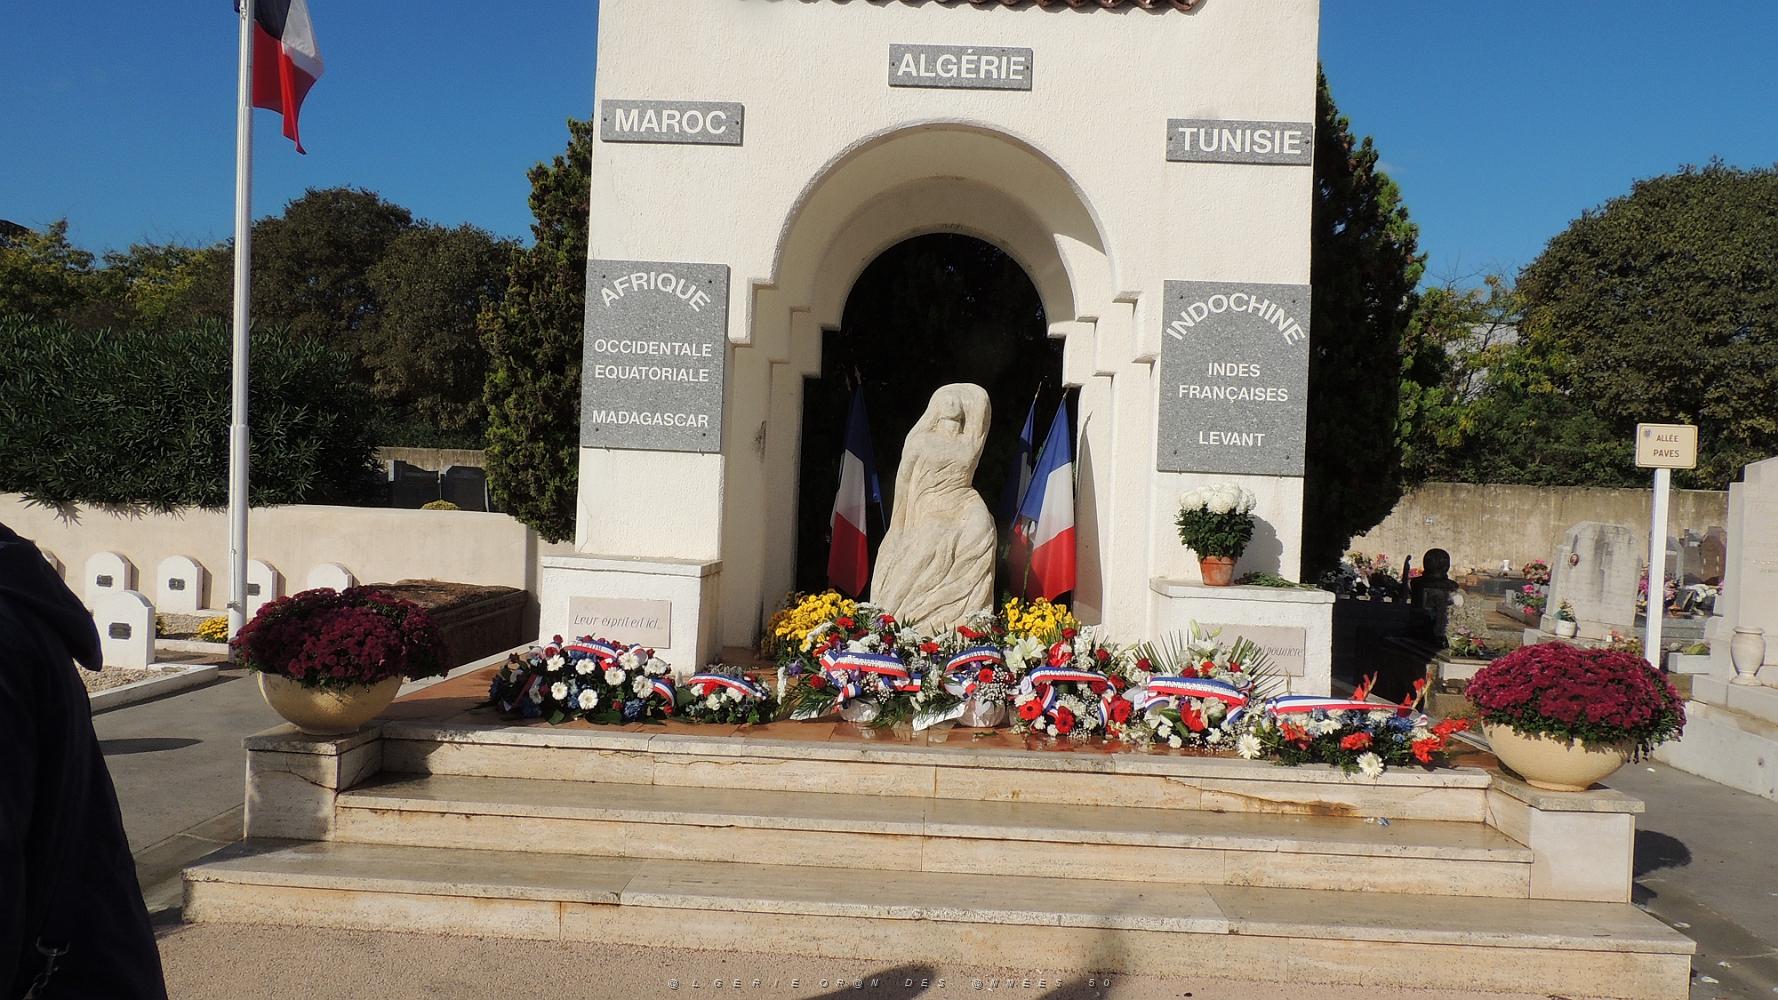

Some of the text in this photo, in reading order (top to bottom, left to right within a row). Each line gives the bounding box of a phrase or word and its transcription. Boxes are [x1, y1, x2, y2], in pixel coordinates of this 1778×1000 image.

[896, 49, 1026, 81] ALGÉRIE
[614, 107, 728, 135] MAROC
[1178, 127, 1302, 154] TUNISIE
[600, 271, 711, 312] AFRIQUE
[1166, 293, 1306, 345] INDOCHINE
[594, 339, 712, 357] OCCIDENTALE
[594, 365, 709, 382] EQUATORIALE
[1207, 362, 1261, 377] INDES
[1178, 385, 1289, 403] FRANÇAISES
[592, 410, 709, 428] MADAGASCAR
[1199, 431, 1266, 447] LEVANT
